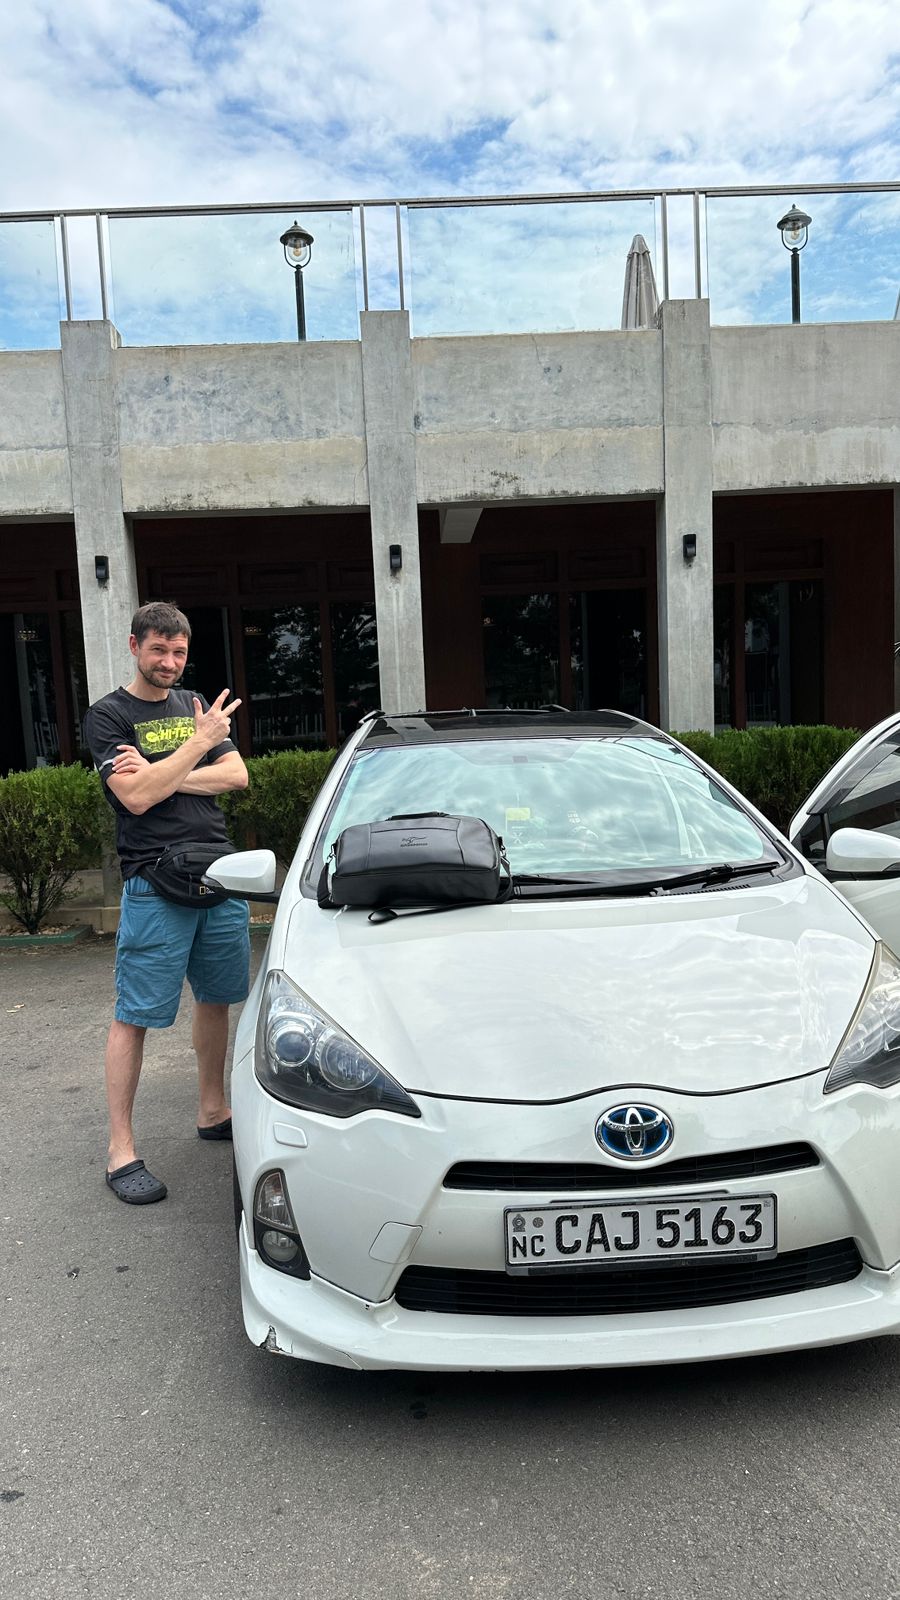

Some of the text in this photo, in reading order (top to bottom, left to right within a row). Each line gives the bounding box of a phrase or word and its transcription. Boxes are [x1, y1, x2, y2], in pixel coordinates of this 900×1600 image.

[161, 727, 194, 740] HI-TEC
[555, 1204, 762, 1253] CAJ 5163
[512, 1235, 545, 1258] NC
